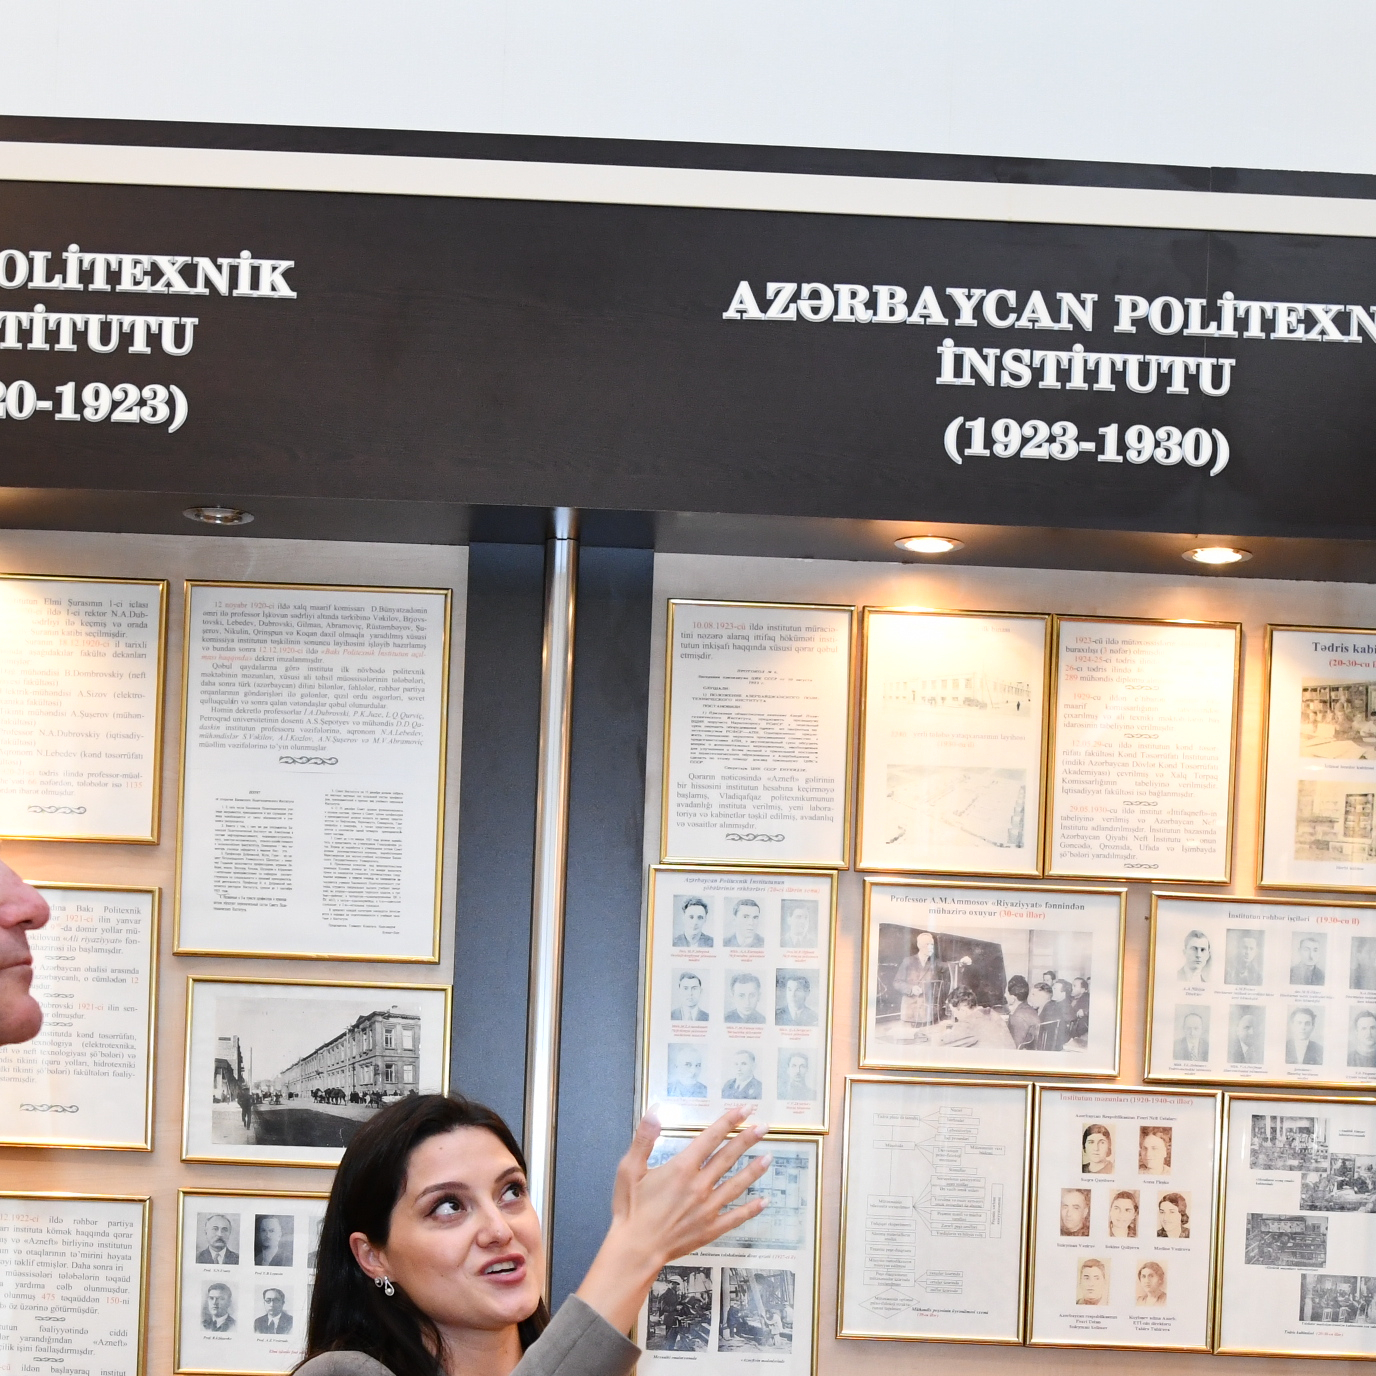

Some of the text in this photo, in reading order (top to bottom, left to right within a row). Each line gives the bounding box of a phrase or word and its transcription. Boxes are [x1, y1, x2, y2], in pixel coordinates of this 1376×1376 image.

[722, 280, 1099, 332] AZƏRBAYCAN
[936, 337, 1236, 397] İNSTİTUTU
[944, 416, 1230, 477] (1923-1930)
[749, 623, 764, 631] ildə
[1312, 642, 1349, 653] Tədris
[1329, 659, 1370, 668] (20-30-cu
[890, 894, 1086, 911] Professor A.M.Ammosov «Riyaziyyat» fənnindən
[928, 907, 967, 915] mühazirə
[999, 909, 1024, 918] (30-cu
[1026, 910, 1046, 920] illər)
[49, 1215, 64, 1224] ildə
[73, 1217, 98, 1226] rəhbər
[107, 1221, 134, 1230] partiya
[46, 1227, 72, 1236] kömək
[75, 1228, 110, 1239] haqqında
[113, 1232, 133, 1240] qərar
[23, 1237, 59, 1246] «Azneft»
[62, 1239, 94, 1249] birliyinə
[97, 1242, 133, 1250] institutun
[21, 1364, 40, 1372] ildən
[50, 1365, 90, 1376] başlayaraq
